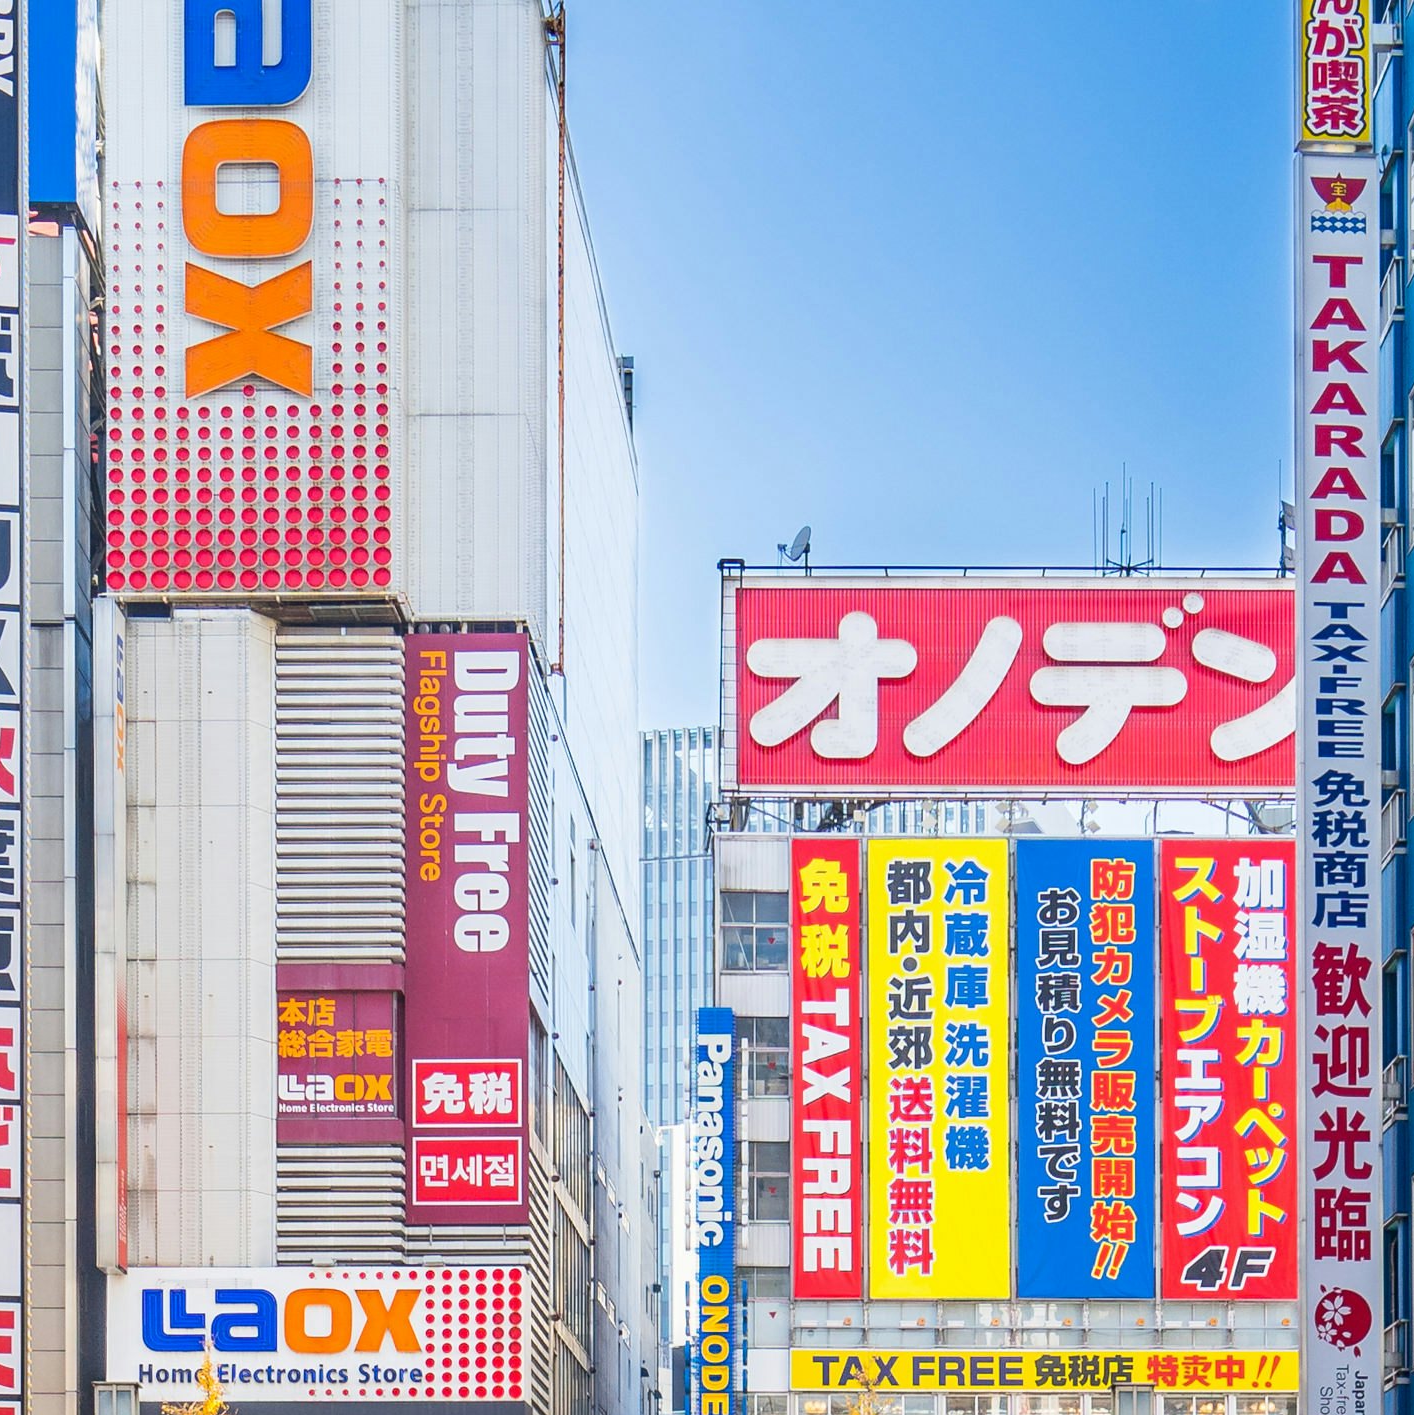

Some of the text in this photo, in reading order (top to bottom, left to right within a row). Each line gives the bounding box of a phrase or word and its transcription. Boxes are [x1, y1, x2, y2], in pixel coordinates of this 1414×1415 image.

[1310, 254, 1367, 585] TAKARADA
[747, 592, 1295, 766] オノデン
[1311, 602, 1368, 759] TAX-FREE
[414, 650, 448, 882] Flagship Store
[447, 650, 521, 952] Duty Free
[798, 857, 852, 979] 免税
[1311, 770, 1371, 931] 免税商店
[277, 997, 337, 1027] 本店
[277, 1029, 394, 1059] 総合家電
[885, 859, 934, 1276] 都内・近郊送料無料
[944, 859, 991, 1171] 冷蔵庫洗濯機
[1034, 886, 1083, 1224] お見積り無料です
[279, 1103, 395, 1114] Home Electronics Store
[419, 1153, 516, 1188] 면세점
[421, 1070, 513, 1116] 免税
[697, 1033, 732, 1248] Panasonic
[801, 987, 853, 1273] TAX FREE
[1311, 943, 1372, 1263] 歓迎光臨
[1180, 1246, 1277, 1291] 4F
[217, 1362, 349, 1385] Electronics
[358, 1363, 424, 1385] Store
[812, 1356, 1024, 1386] TAX FREE
[1036, 1355, 1134, 1388] 免税店
